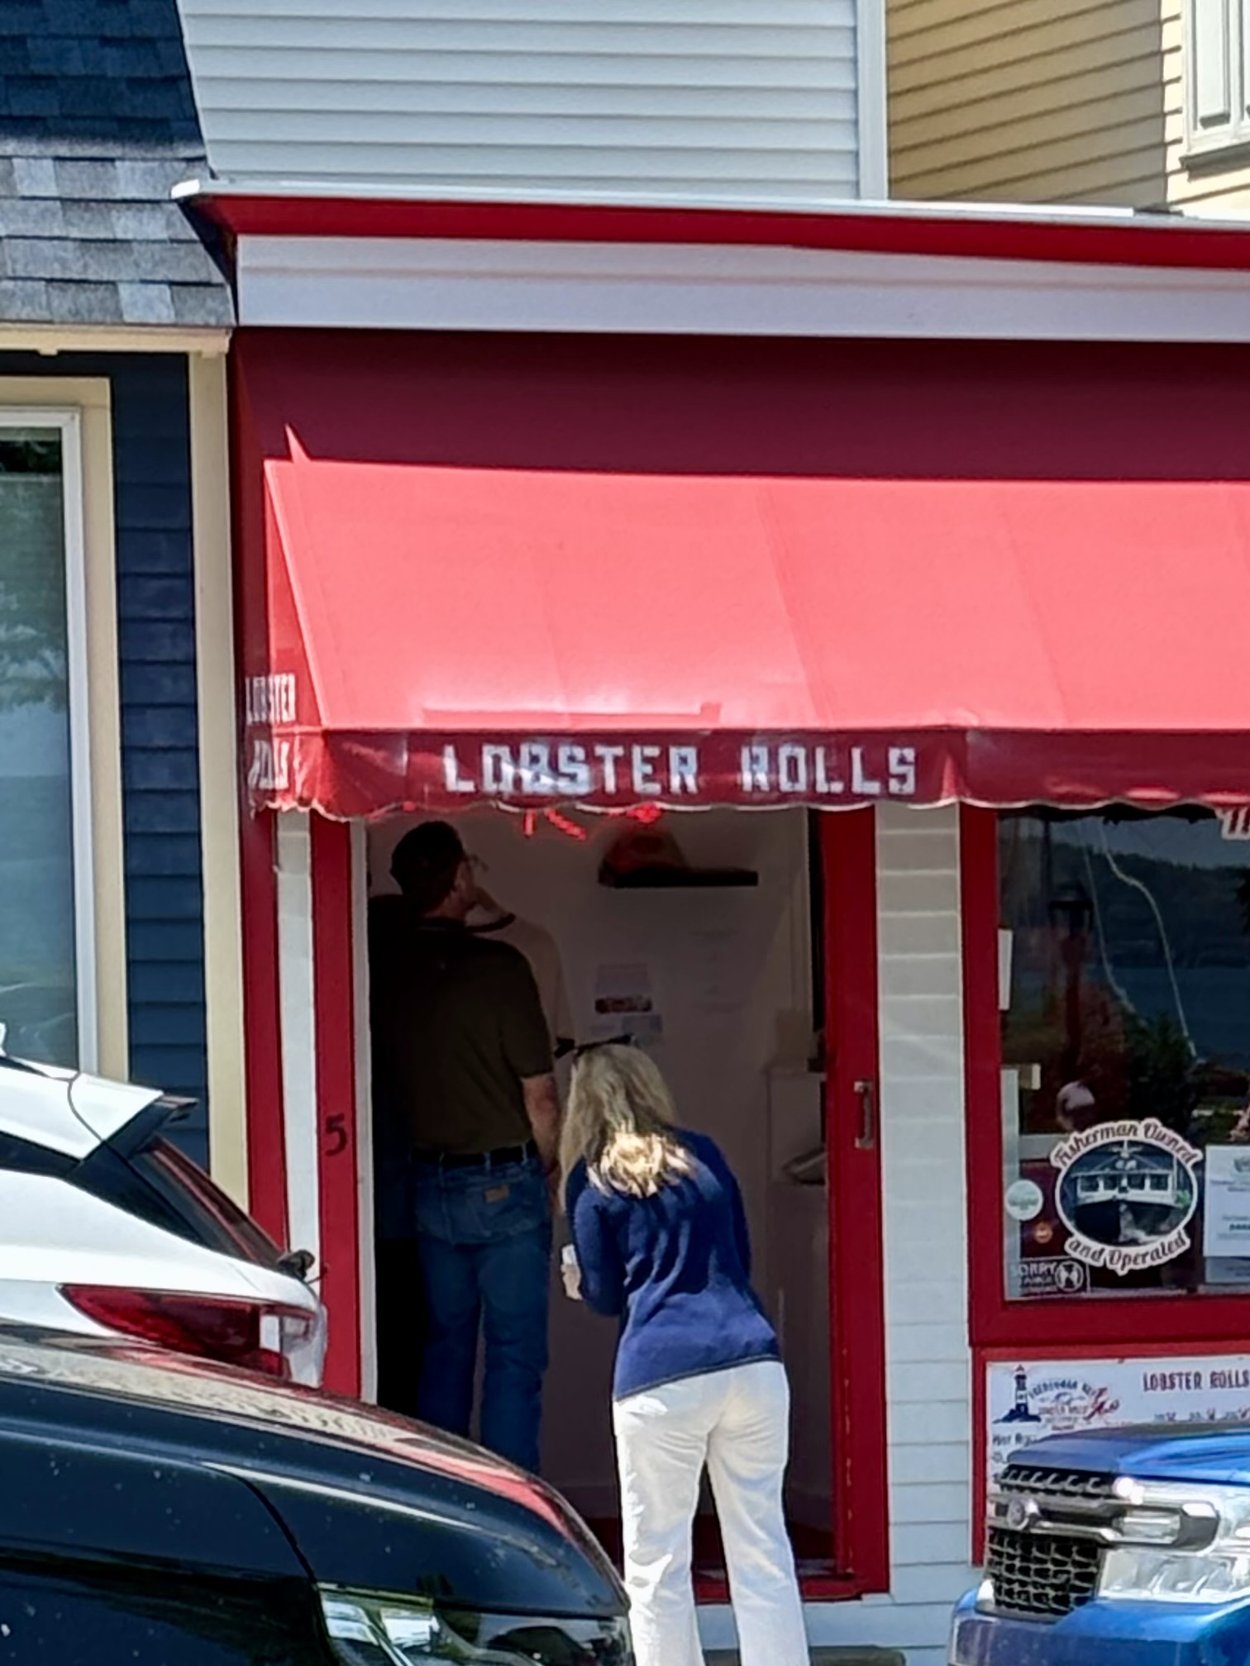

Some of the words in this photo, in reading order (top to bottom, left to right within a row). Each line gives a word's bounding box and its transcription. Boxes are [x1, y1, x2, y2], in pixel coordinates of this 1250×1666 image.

[442, 743, 700, 796] LOBSTER
[739, 744, 916, 796] ROLLS
[324, 1112, 347, 1157] 5
[1053, 1123, 1139, 1167] Fisherman
[1143, 1121, 1198, 1165] Owned
[1067, 1238, 1106, 1263] and
[1108, 1228, 1188, 1272] Operated
[1142, 1370, 1202, 1392] LOBSTER
[1208, 1368, 1250, 1389] ROLLS
